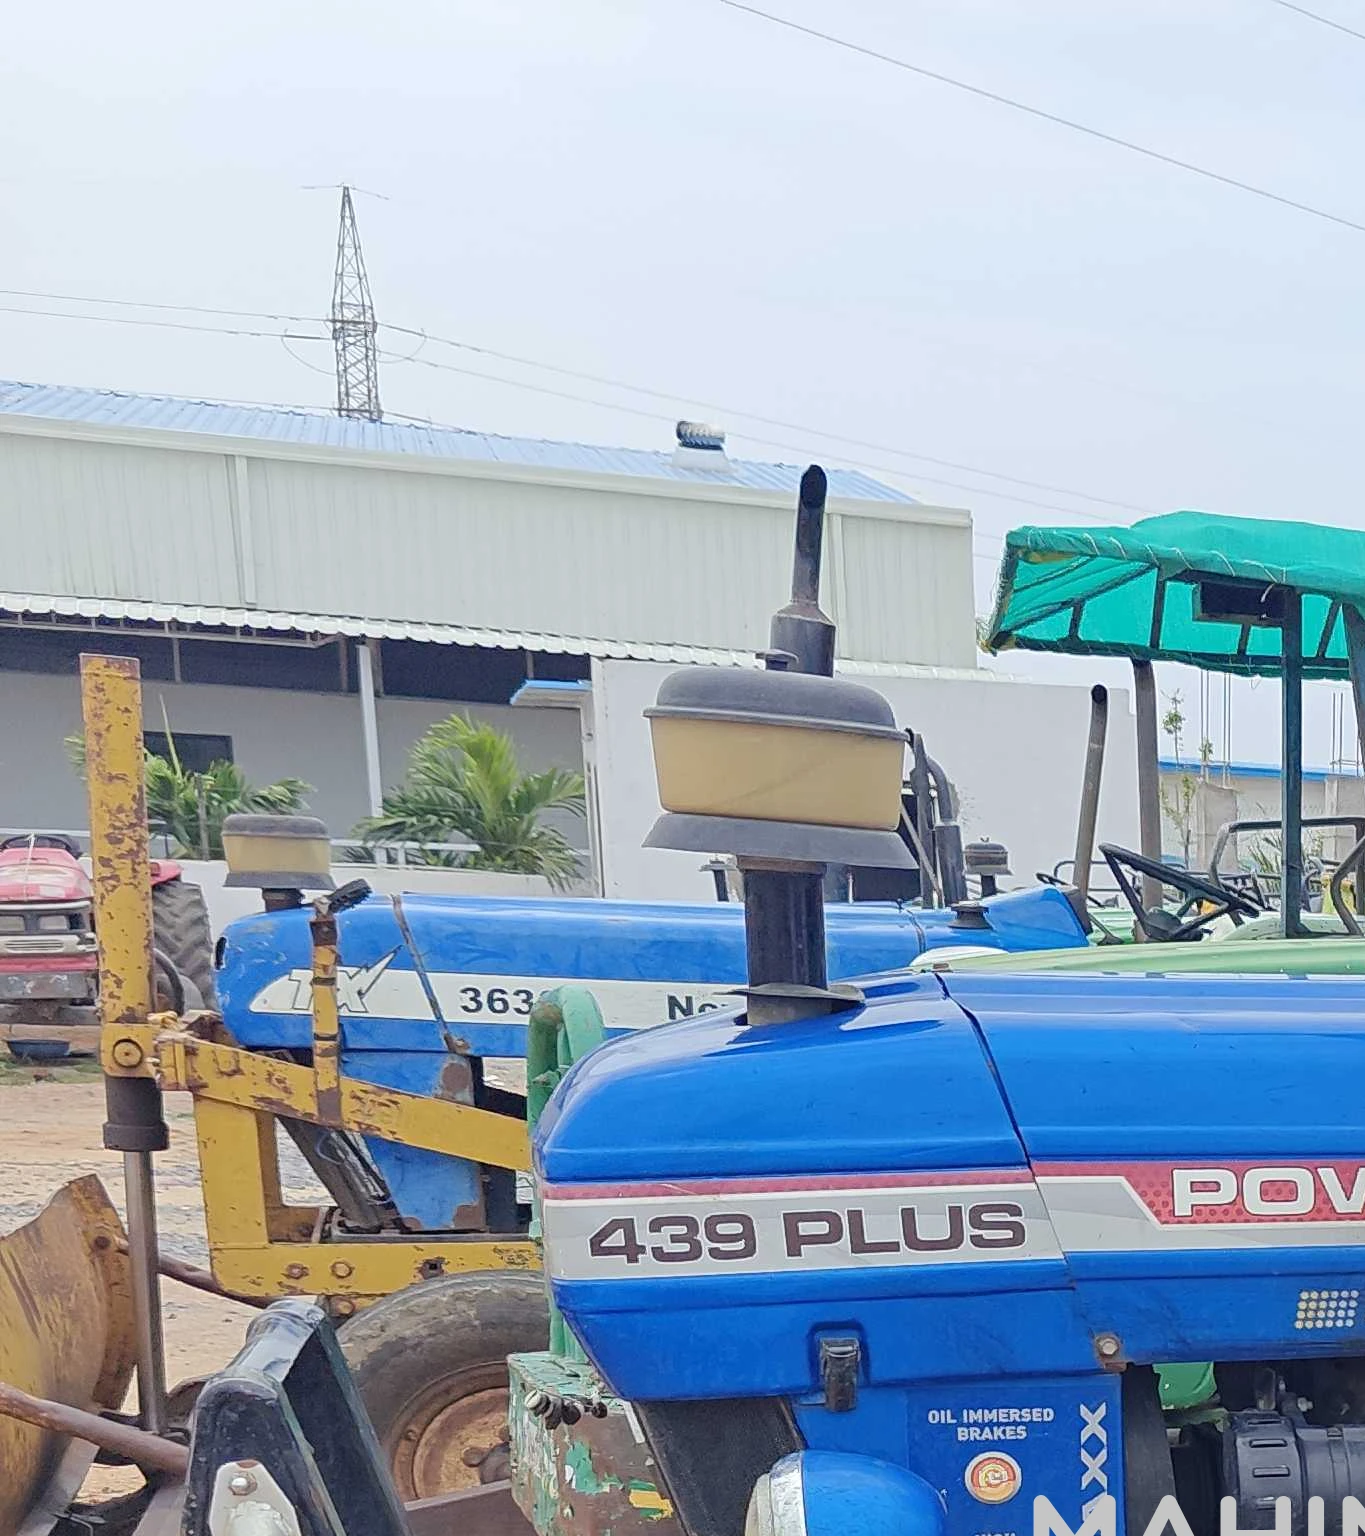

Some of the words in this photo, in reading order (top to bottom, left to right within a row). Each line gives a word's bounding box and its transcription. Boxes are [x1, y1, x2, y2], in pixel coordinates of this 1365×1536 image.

[460, 986, 552, 1015] 363
[588, 1213, 758, 1265] 439
[782, 1202, 1027, 1258] PLUS
[927, 1409, 957, 1425] OIL
[962, 1407, 1055, 1424] IMMERSED
[956, 1425, 1028, 1442] BRAKES
